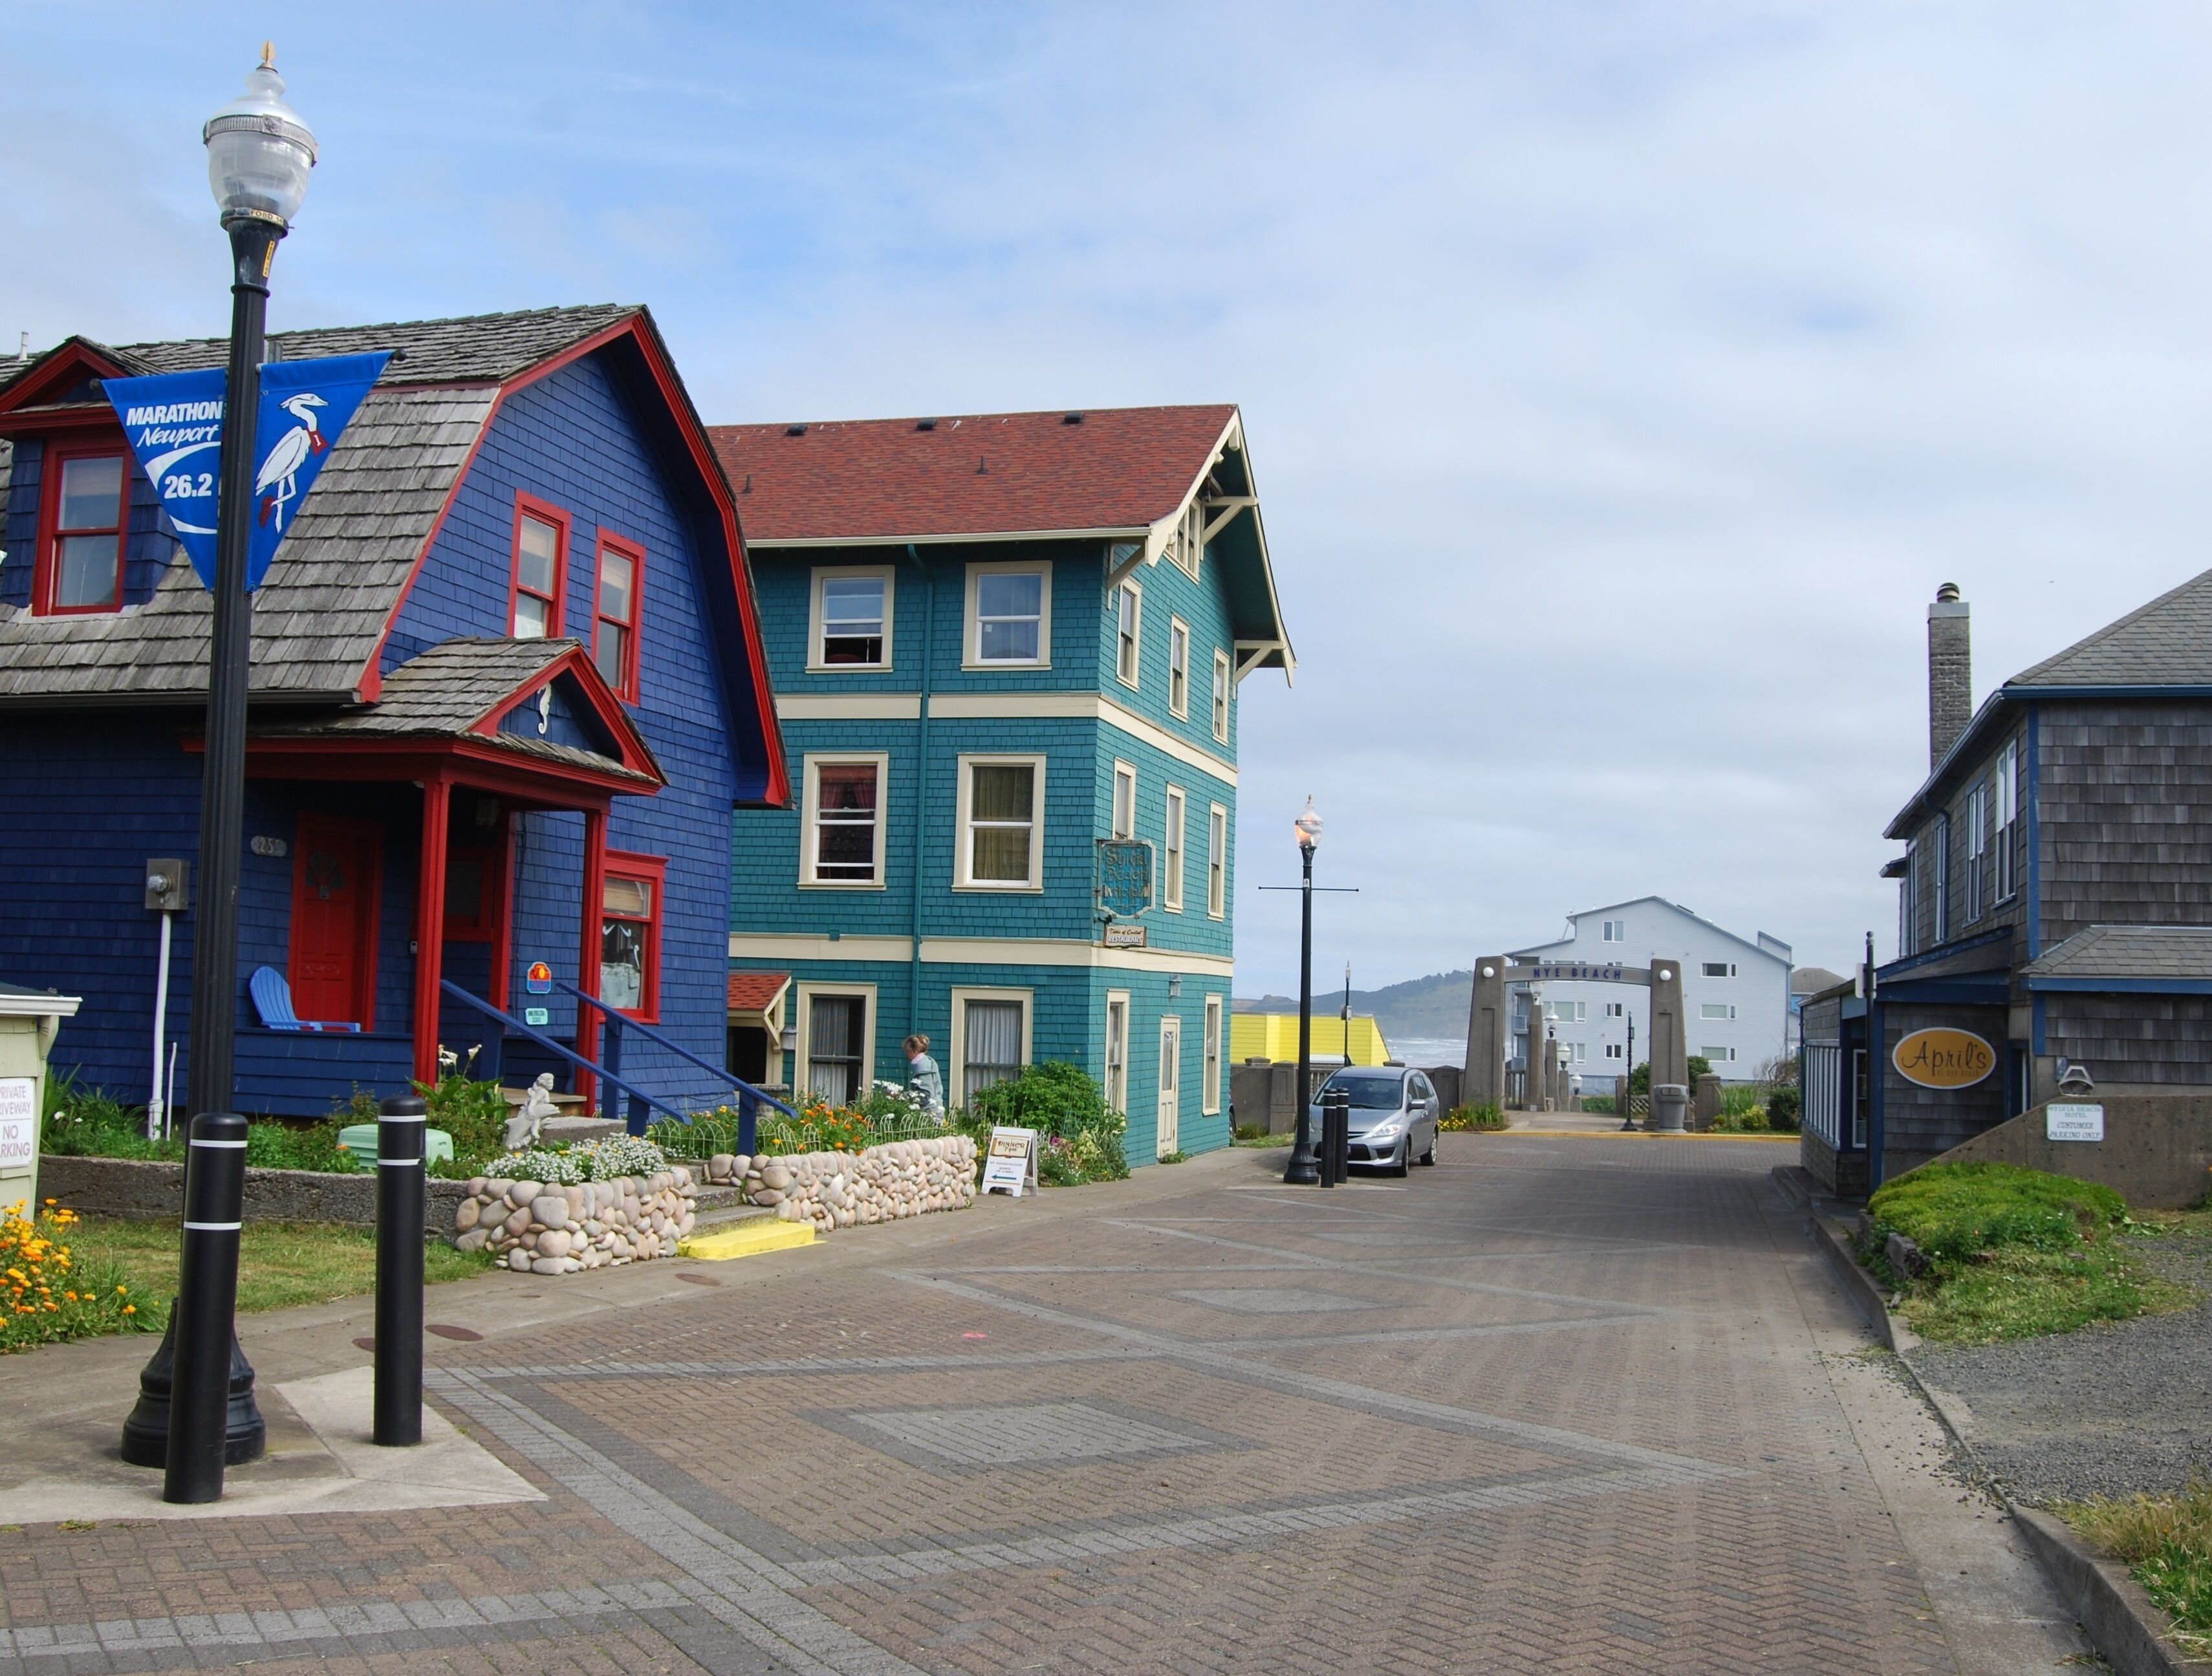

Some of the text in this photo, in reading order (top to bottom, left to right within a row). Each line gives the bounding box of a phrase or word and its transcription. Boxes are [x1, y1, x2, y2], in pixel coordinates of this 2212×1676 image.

[127, 402, 222, 426] MARATHON
[136, 424, 219, 449] Newport
[314, 435, 321, 446] 1
[164, 473, 213, 499] 26.2
[1534, 968, 1621, 980] NYE BEACH
[1902, 1040, 1986, 1076] April's
[0, 1086, 26, 1099] RIVATE
[3, 1125, 18, 1139] NO
[0, 1143, 30, 1157] RKING
